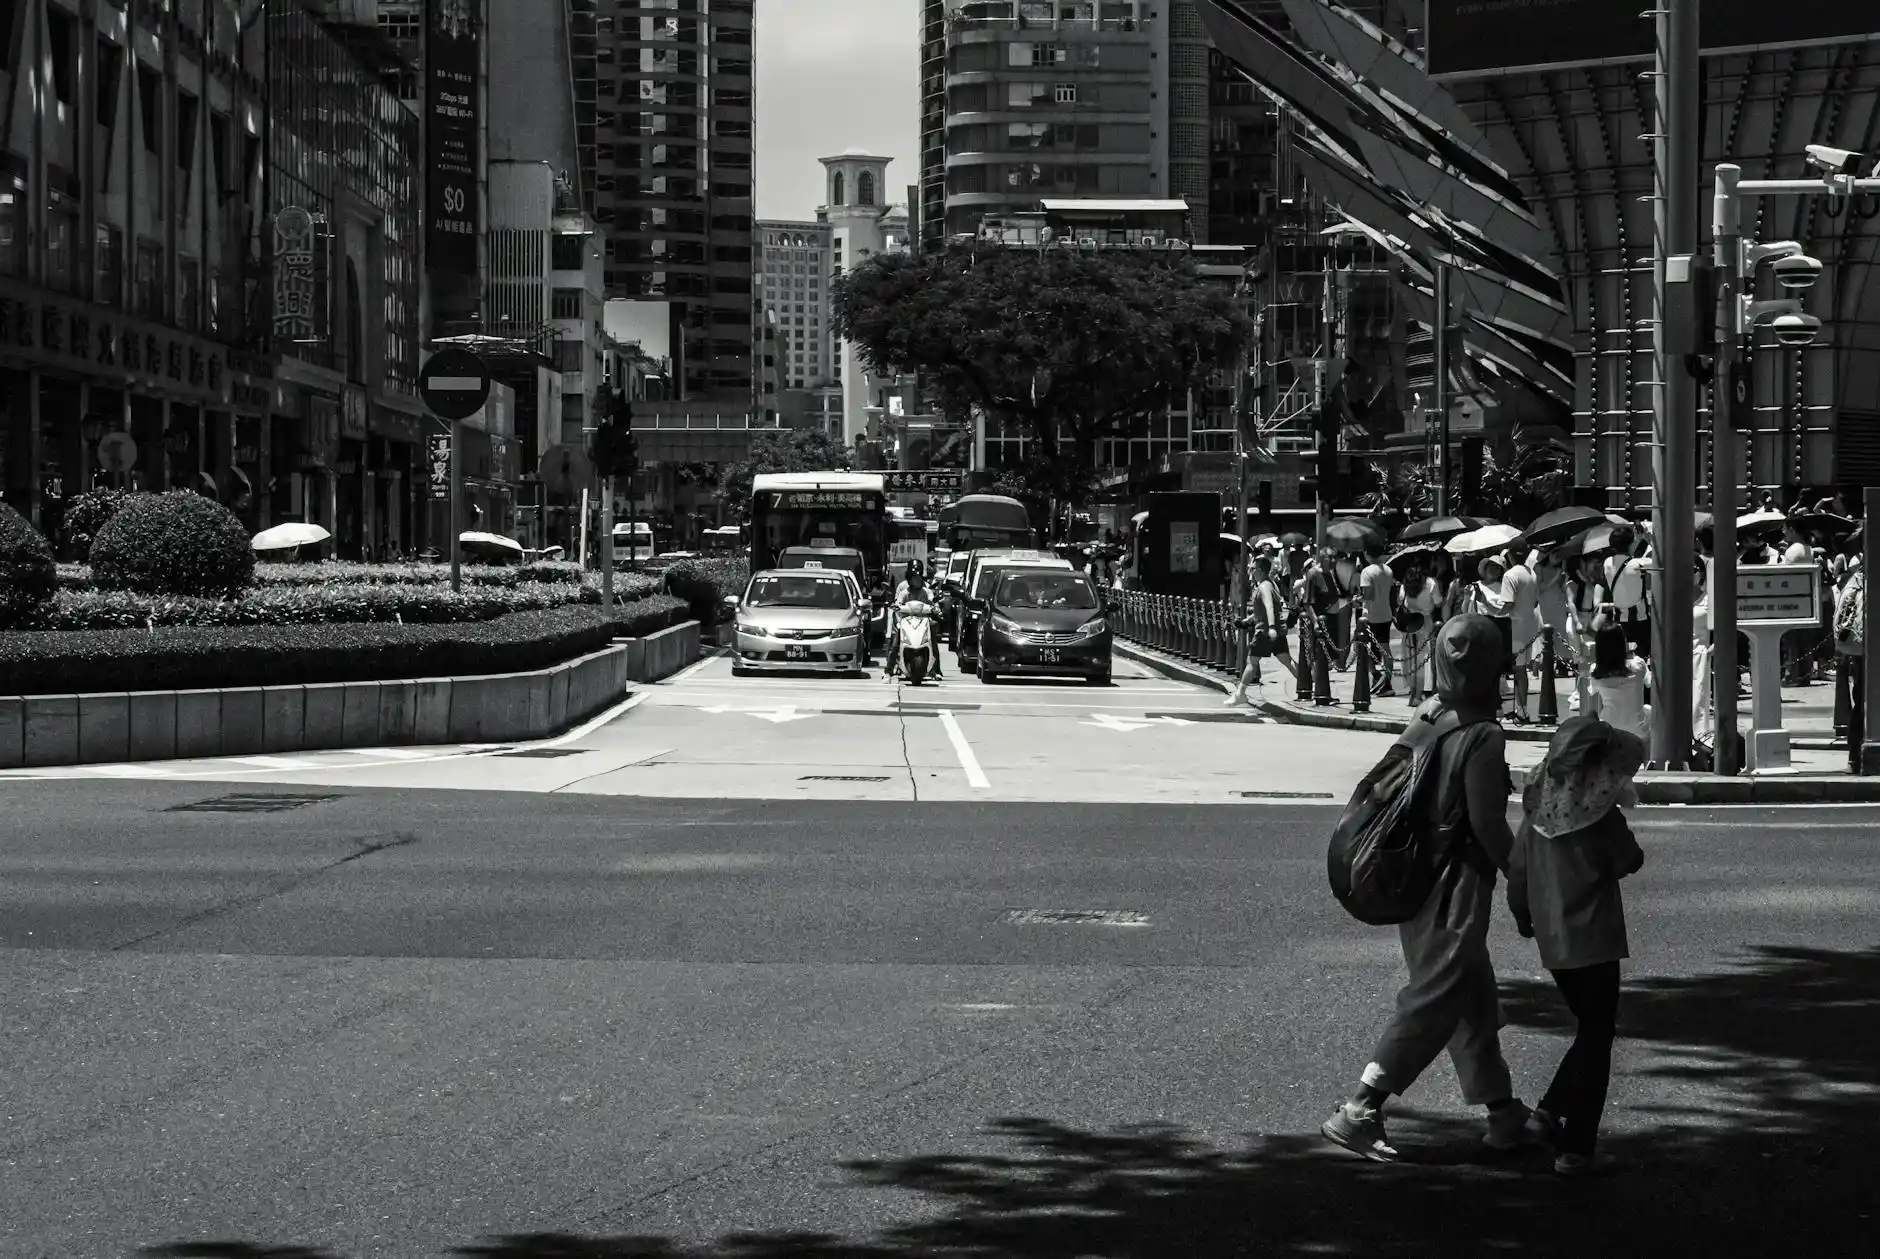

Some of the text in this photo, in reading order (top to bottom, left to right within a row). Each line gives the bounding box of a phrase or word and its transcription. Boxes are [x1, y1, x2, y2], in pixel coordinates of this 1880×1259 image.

[444, 184, 465, 214] $0
[430, 439, 451, 483] 湯泉
[772, 493, 782, 509] 7
